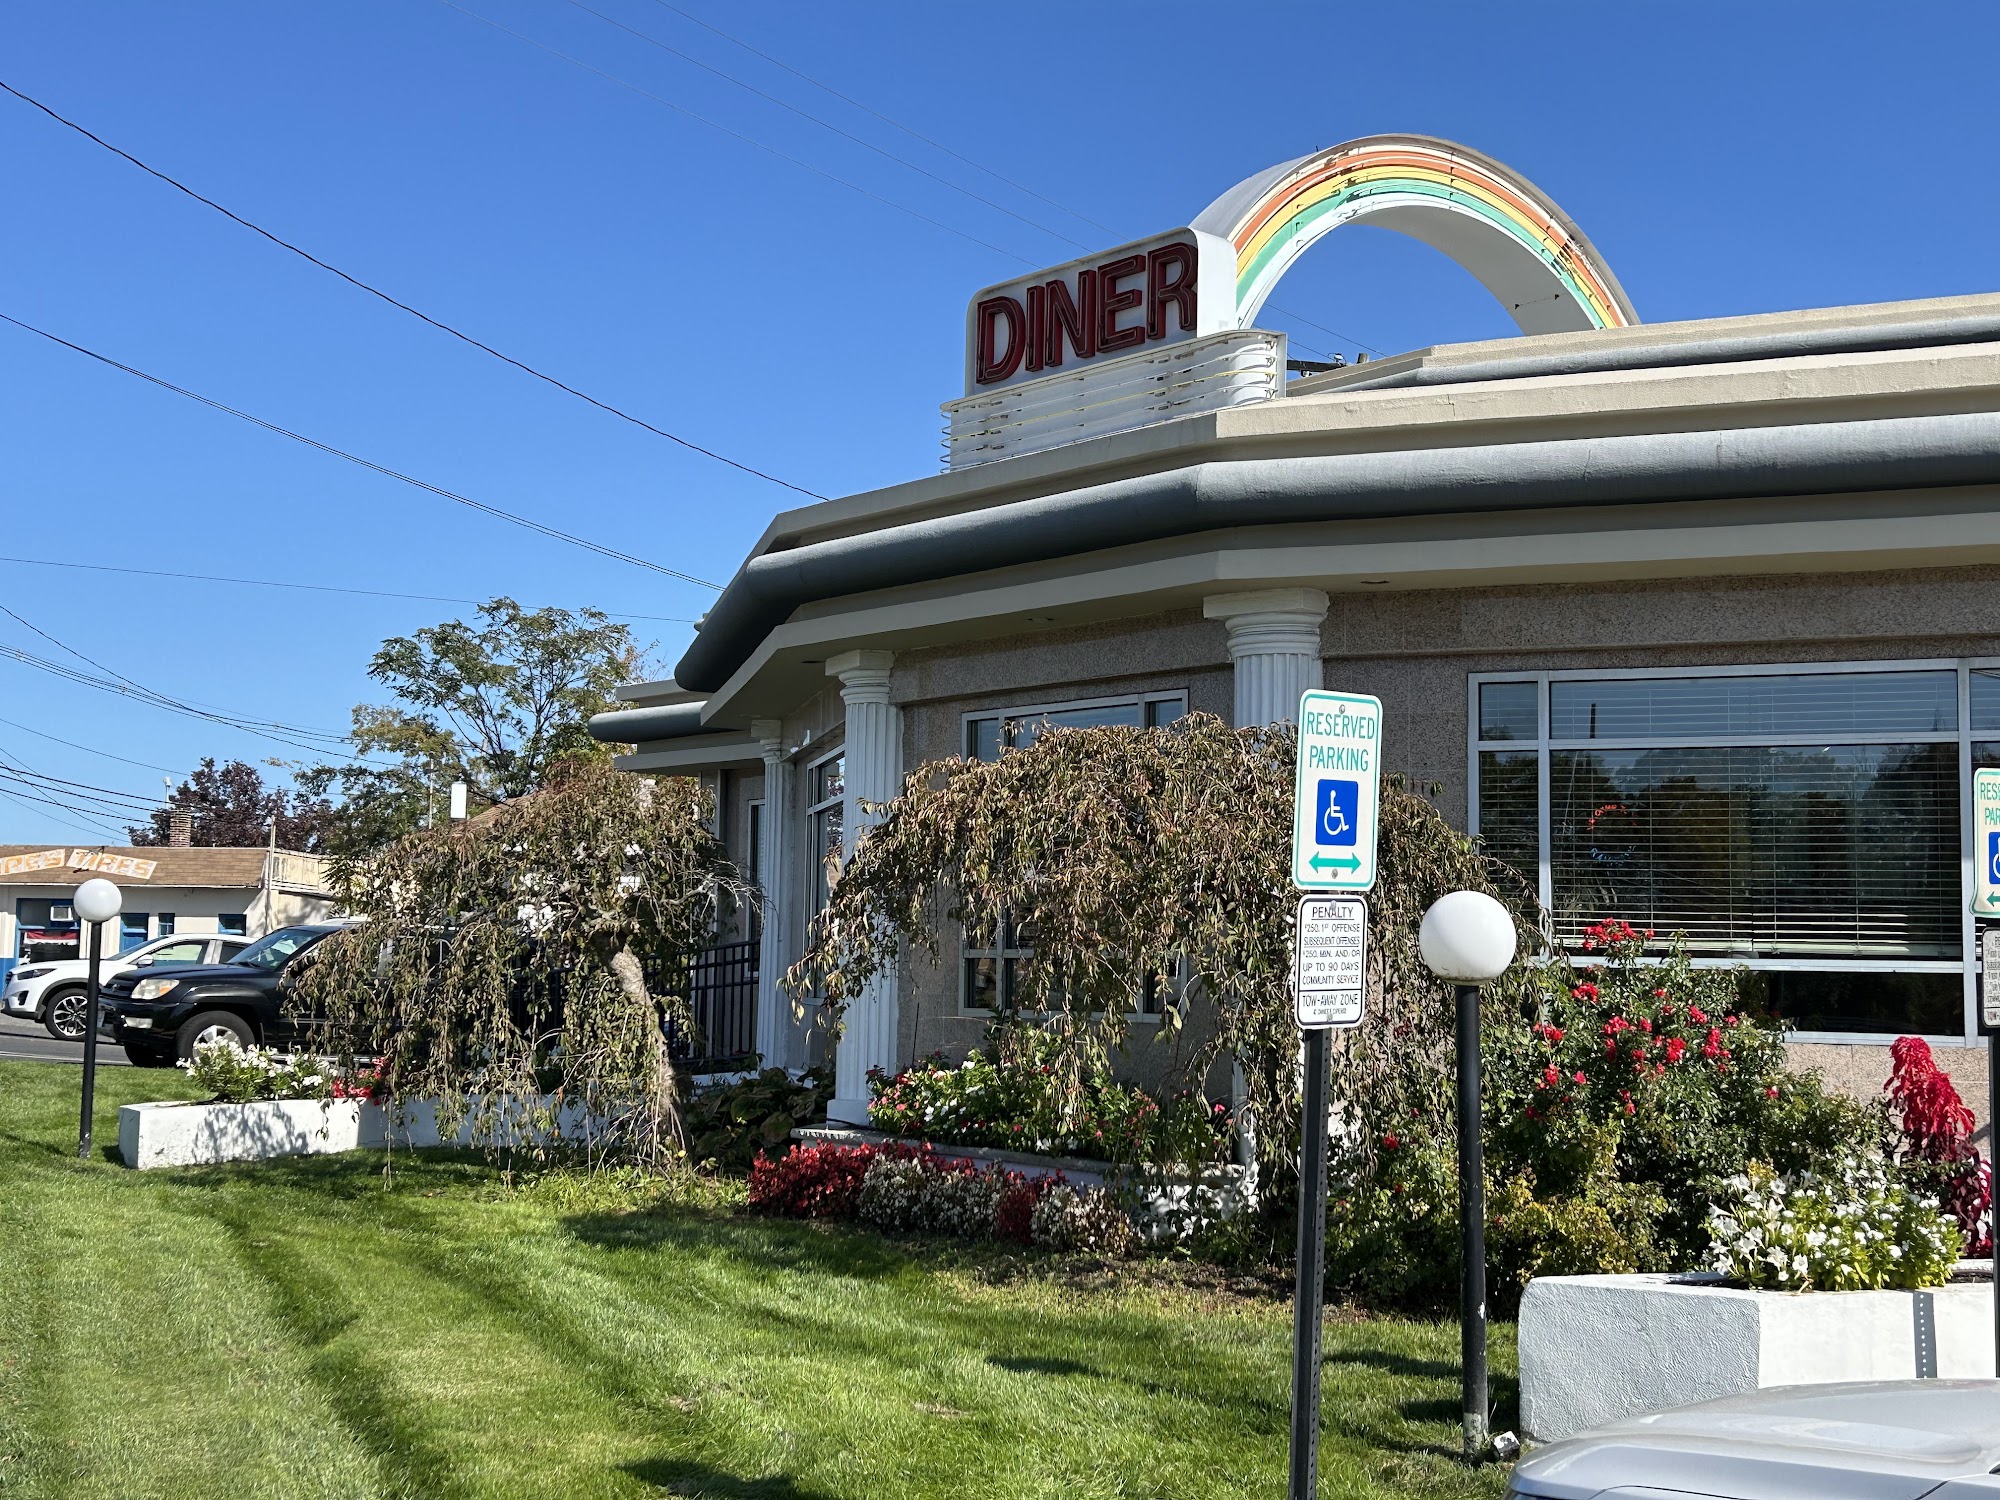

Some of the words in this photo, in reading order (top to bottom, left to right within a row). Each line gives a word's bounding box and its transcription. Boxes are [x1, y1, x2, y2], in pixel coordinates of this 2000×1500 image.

[975, 242, 1198, 384] DINER
[1306, 712, 1375, 739] RESERVED
[1309, 745, 1369, 772] PARKING
[1312, 906, 1354, 918] PENALTY
[1331, 923, 1360, 933] OFFENSE
[1303, 962, 1313, 972] UP
[1316, 962, 1325, 972] TO
[1328, 962, 1339, 972] 90
[1340, 961, 1360, 971] DAYS
[1302, 975, 1335, 985] COMMUNITY
[1336, 974, 1359, 984] SERVICE
[1302, 994, 1338, 1007] TOW-AWAY
[1340, 993, 1359, 1006] ZONE
